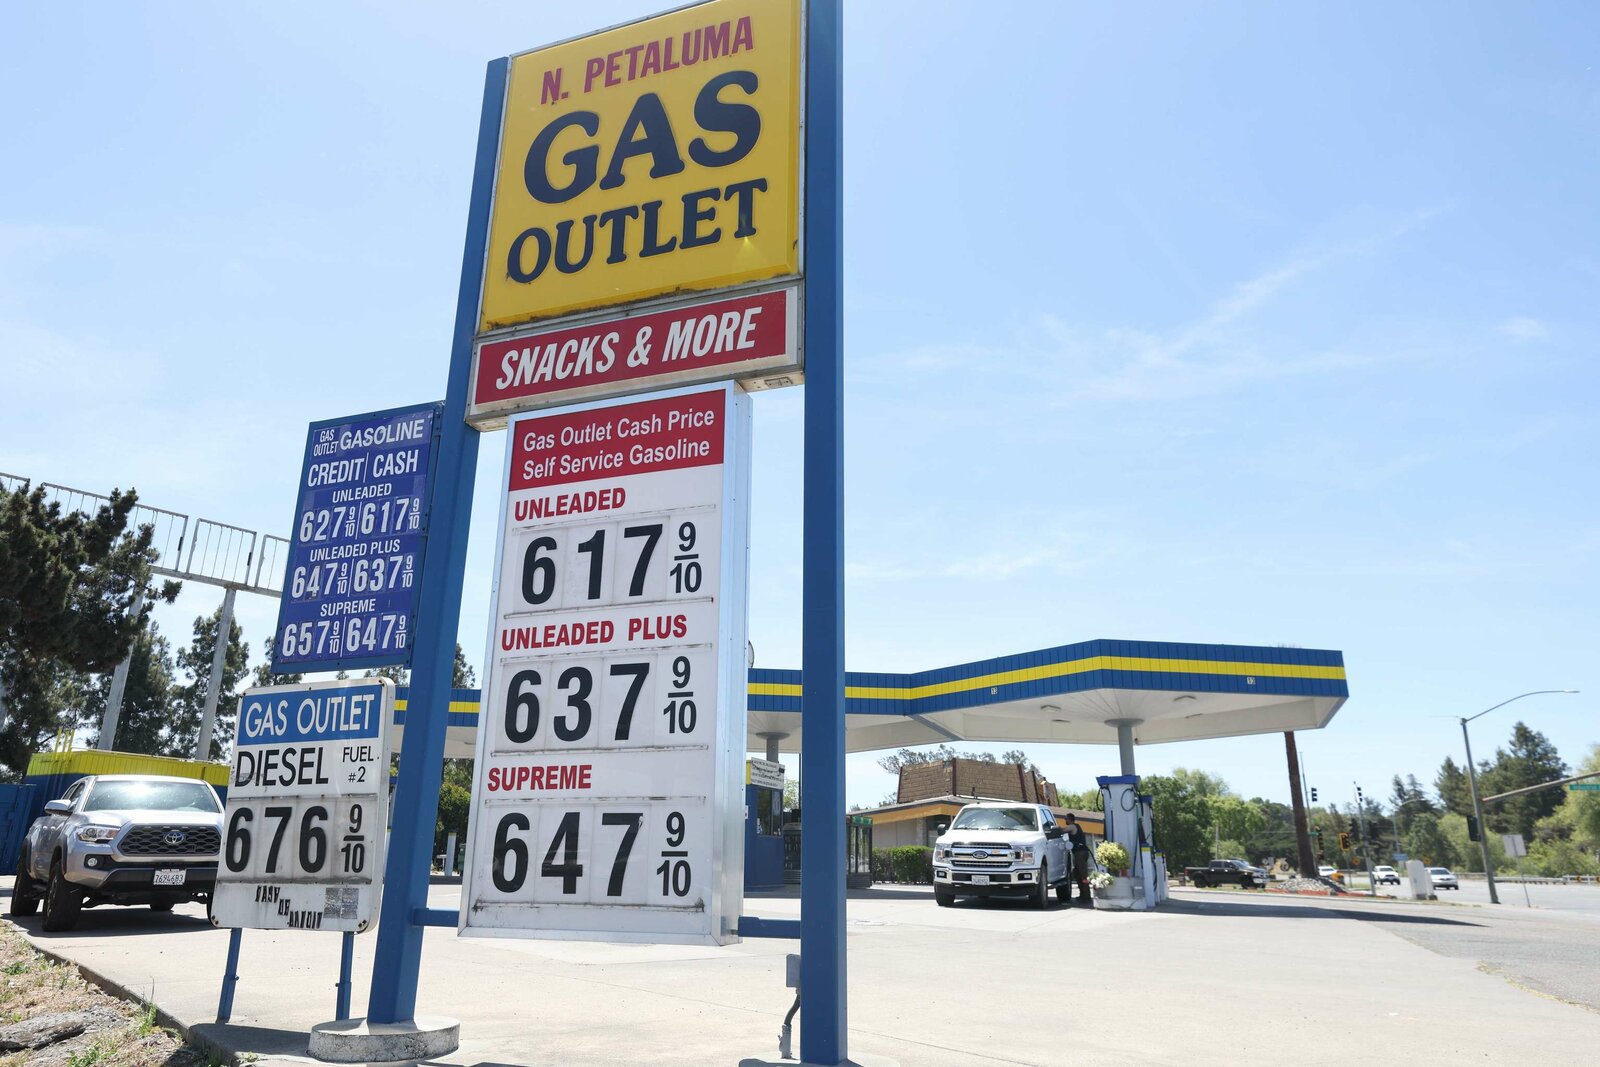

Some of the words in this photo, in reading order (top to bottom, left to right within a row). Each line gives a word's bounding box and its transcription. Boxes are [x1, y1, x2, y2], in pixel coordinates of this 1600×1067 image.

[540, 68, 569, 104] N.
[583, 15, 754, 93] PETALUMA
[524, 71, 761, 204] GAS
[507, 178, 768, 284] OUTLET
[496, 331, 620, 390] SNACKS
[626, 326, 653, 367] &
[661, 307, 763, 362] MORE
[319, 430, 335, 443] GAS
[340, 419, 425, 451] GASOLINE
[523, 432, 555, 452] Gas
[560, 422, 612, 447] Outlet
[617, 413, 662, 439] Cash
[667, 408, 715, 431] Price
[313, 441, 339, 457] OUTLET
[372, 449, 419, 478] CASH
[522, 457, 557, 481] Self
[559, 450, 624, 475] Service
[629, 438, 710, 463] Gasoline
[307, 458, 365, 487] CREDIT
[332, 483, 392, 504] UNLEADED
[514, 487, 626, 522] UNLEADED
[299, 506, 347, 543] 627
[361, 499, 410, 535] 617
[309, 542, 367, 562] UNLEADED
[370, 539, 401, 555] PLUS
[521, 523, 663, 605] 617
[291, 563, 339, 598] 647
[353, 556, 403, 592] 637
[320, 599, 376, 617] SUPREME
[282, 620, 331, 657] 657
[346, 614, 397, 652] 647
[501, 620, 615, 651] UNLEADED
[628, 614, 688, 642] PLUS
[245, 699, 289, 738] GAS
[296, 694, 375, 735] OUTLET
[504, 662, 650, 744] 637
[234, 747, 329, 787] DIESEL
[342, 746, 374, 763] FUEL
[348, 766, 366, 783] #2
[487, 764, 593, 792] SUPREME
[225, 805, 329, 874] 676
[491, 811, 644, 897] 647
